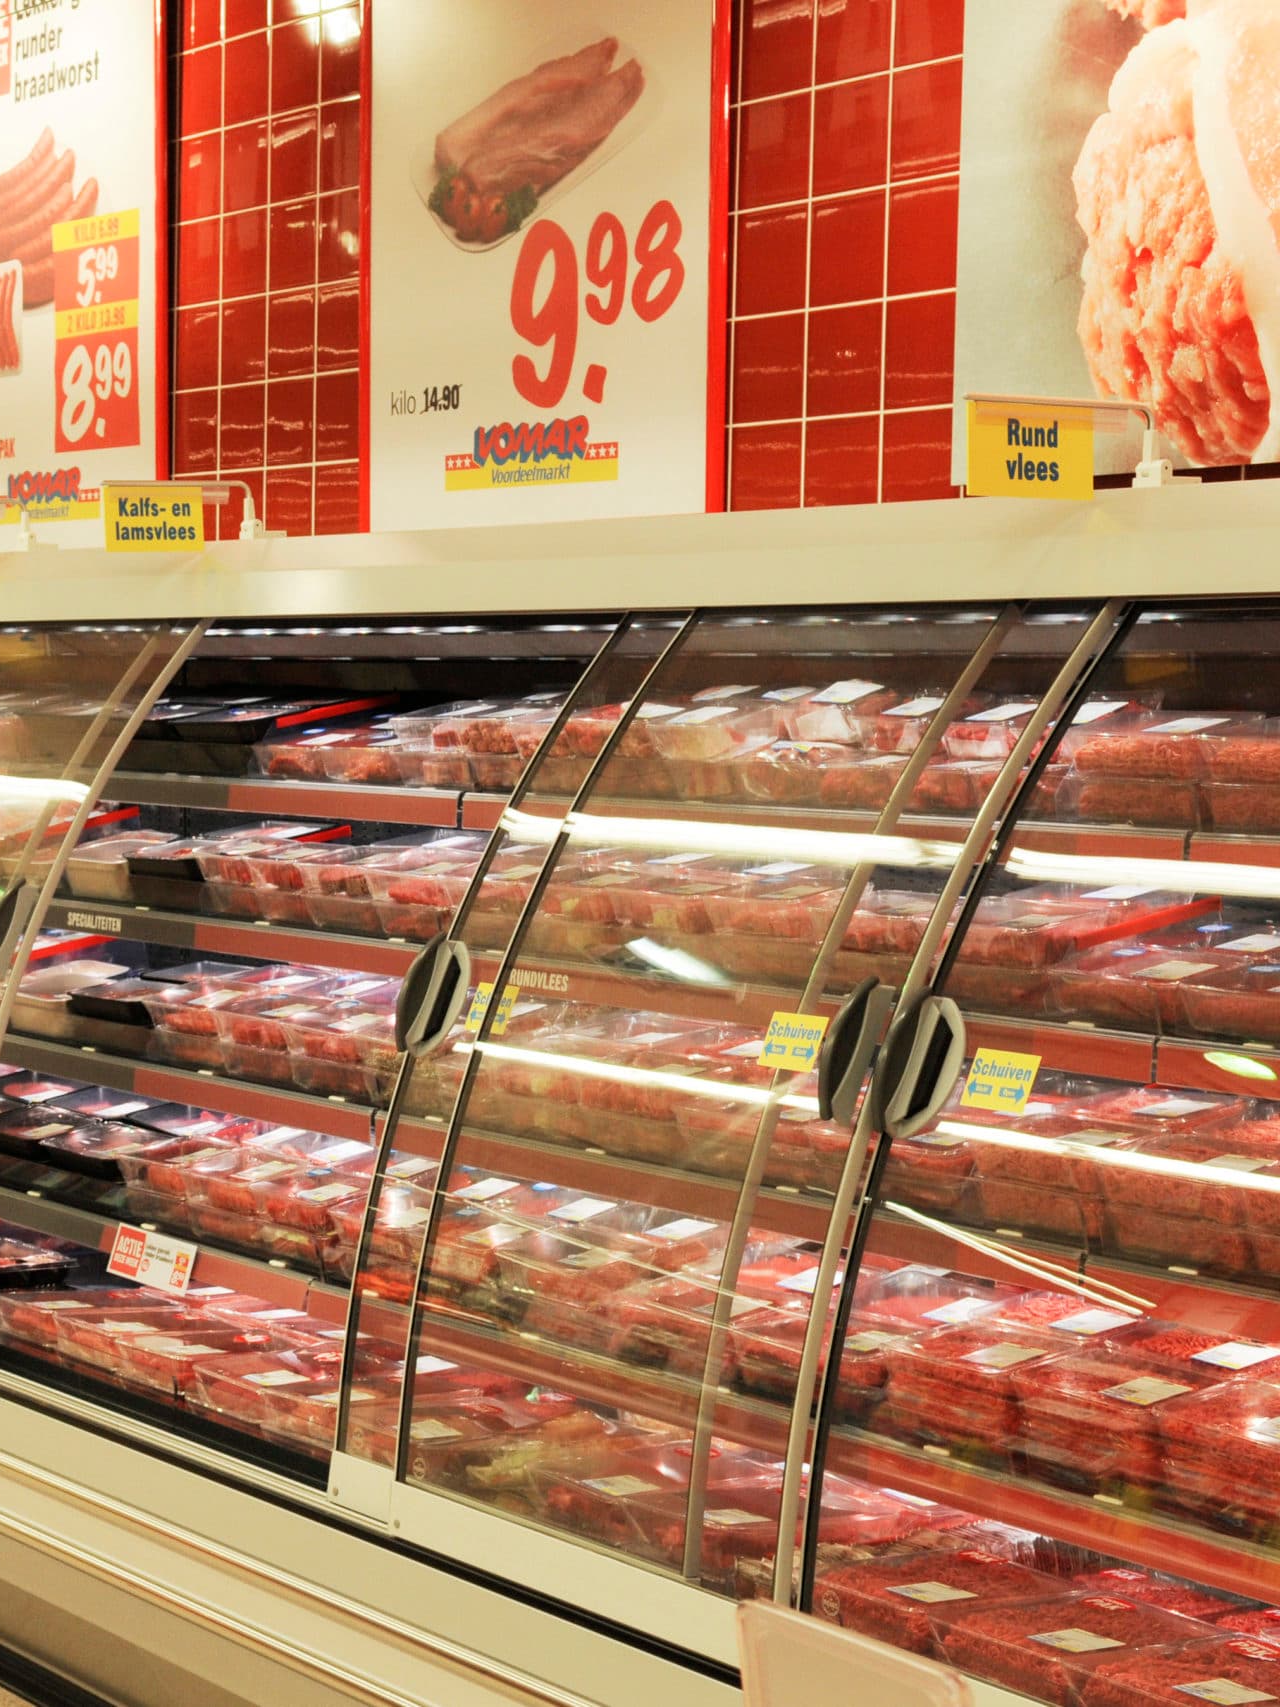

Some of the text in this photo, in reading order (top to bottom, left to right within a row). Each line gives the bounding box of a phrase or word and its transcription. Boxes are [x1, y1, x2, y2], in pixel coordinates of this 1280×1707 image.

[15, 23, 63, 63] runder
[14, 50, 100, 103] braadworst
[76, 245, 118, 307] 5.99
[510, 200, 685, 408] 9.98
[61, 341, 132, 443] 8.99
[391, 383, 460, 416] kilo 14.90
[474, 415, 589, 467] VOMAR
[1006, 418, 1059, 448] Rund
[491, 464, 571, 484] Voordeelmarkt
[1006, 452, 1060, 481] vlees
[8, 466, 81, 505] VOMAR
[118, 497, 191, 518] Kalfs- en
[115, 520, 196, 541] lamsvlees
[67, 911, 122, 933] SPECIALITEITEN
[509, 968, 569, 992] RUNDVLEES
[474, 991, 513, 1008] Schen
[769, 1020, 822, 1041] Schuiven
[973, 1058, 1033, 1082] Schuiven
[118, 1236, 144, 1258] ACTIE
